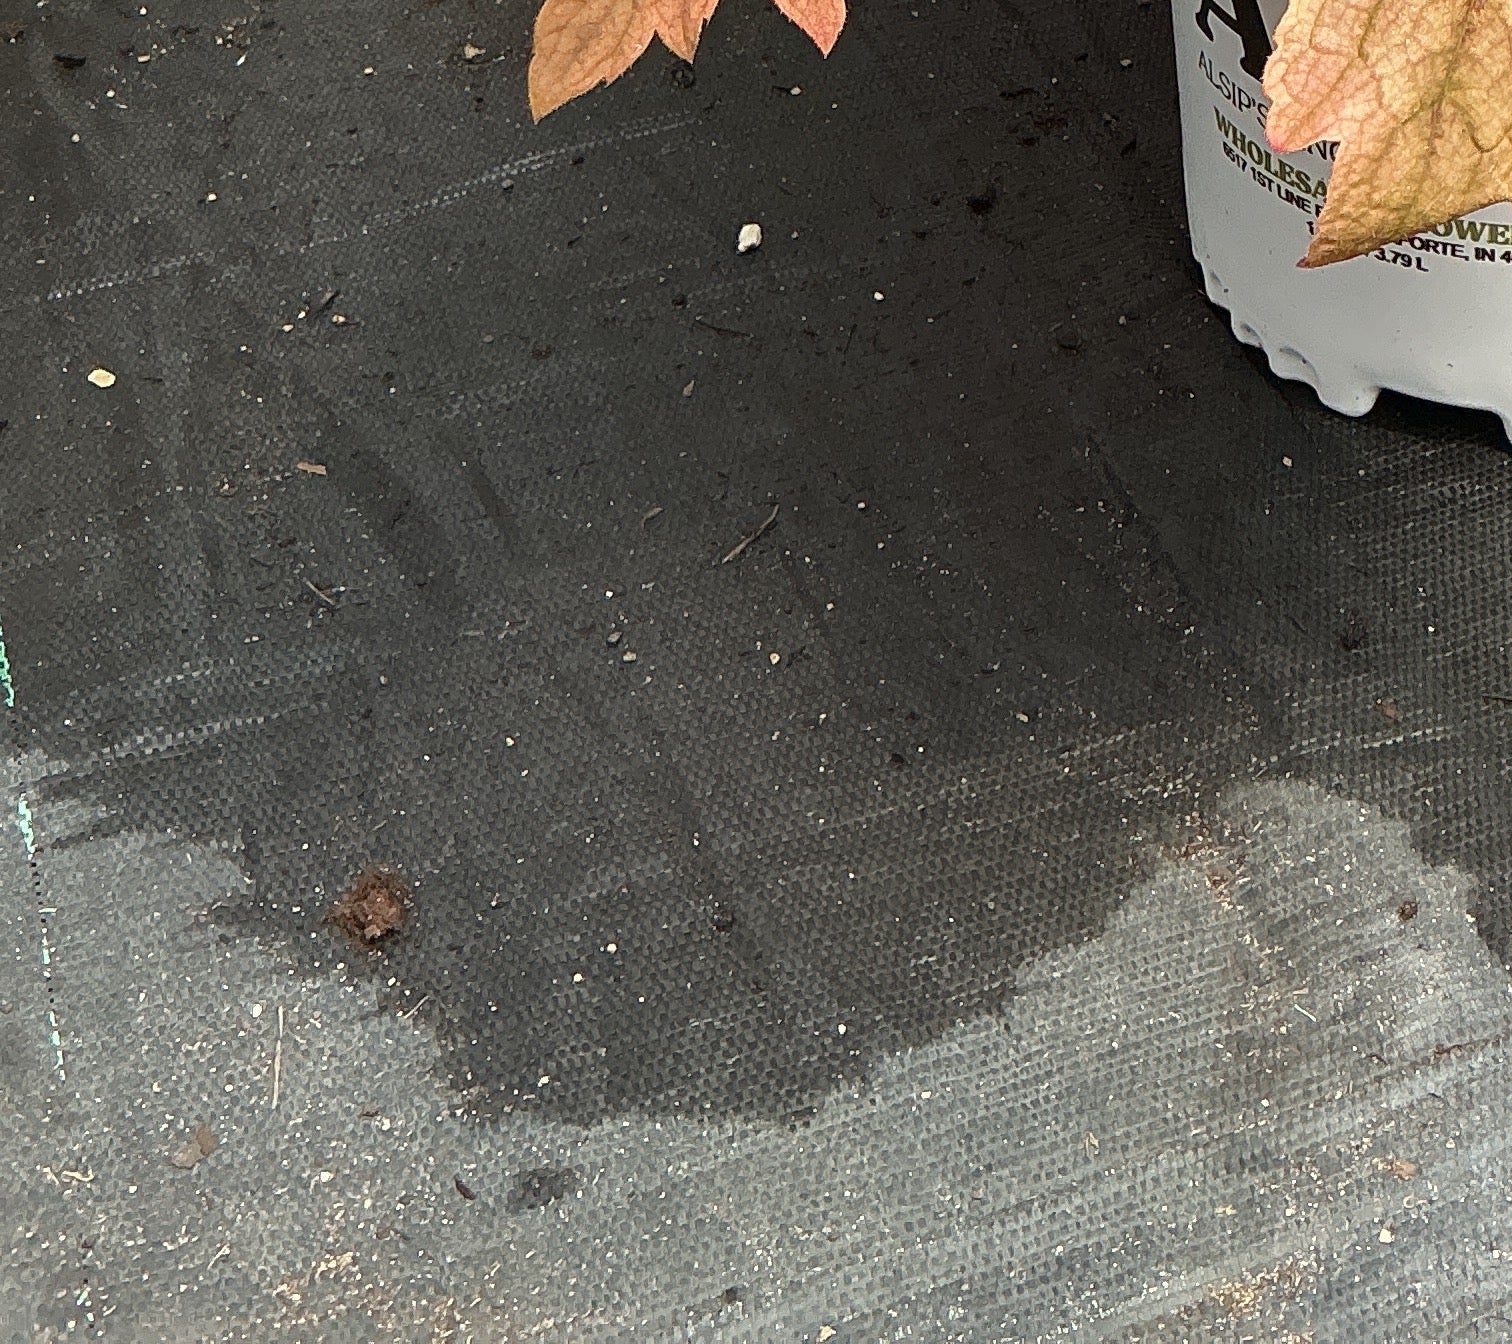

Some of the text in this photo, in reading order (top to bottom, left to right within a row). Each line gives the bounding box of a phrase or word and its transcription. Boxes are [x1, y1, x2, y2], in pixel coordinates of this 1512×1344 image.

[1213, 105, 1328, 200] WHOLESA
[1250, 166, 1275, 193] 1ST
[1276, 183, 1313, 213] LINE
[1374, 247, 1430, 273] 3.79 L
[1400, 236, 1470, 262] ORTE,
[1474, 247, 1497, 263] IN
